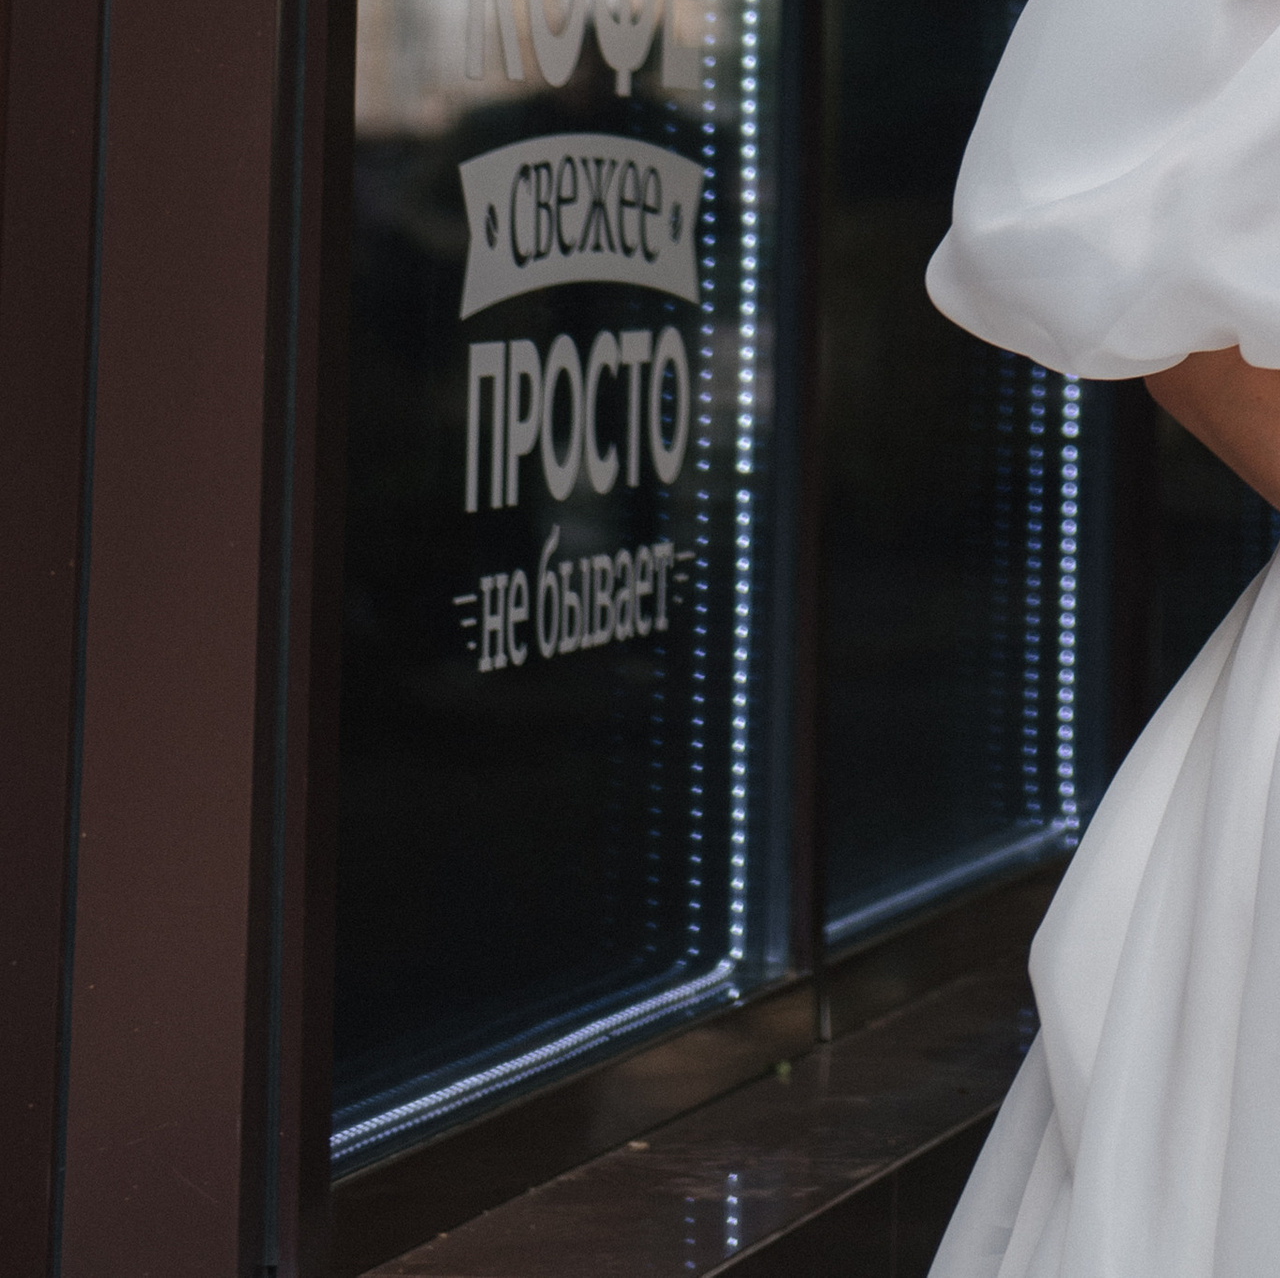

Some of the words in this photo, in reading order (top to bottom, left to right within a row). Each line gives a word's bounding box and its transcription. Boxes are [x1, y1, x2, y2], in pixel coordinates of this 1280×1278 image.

[464, 325, 691, 514] ПРОСТО
[478, 567, 529, 672] не
[536, 524, 675, 658] бывает
